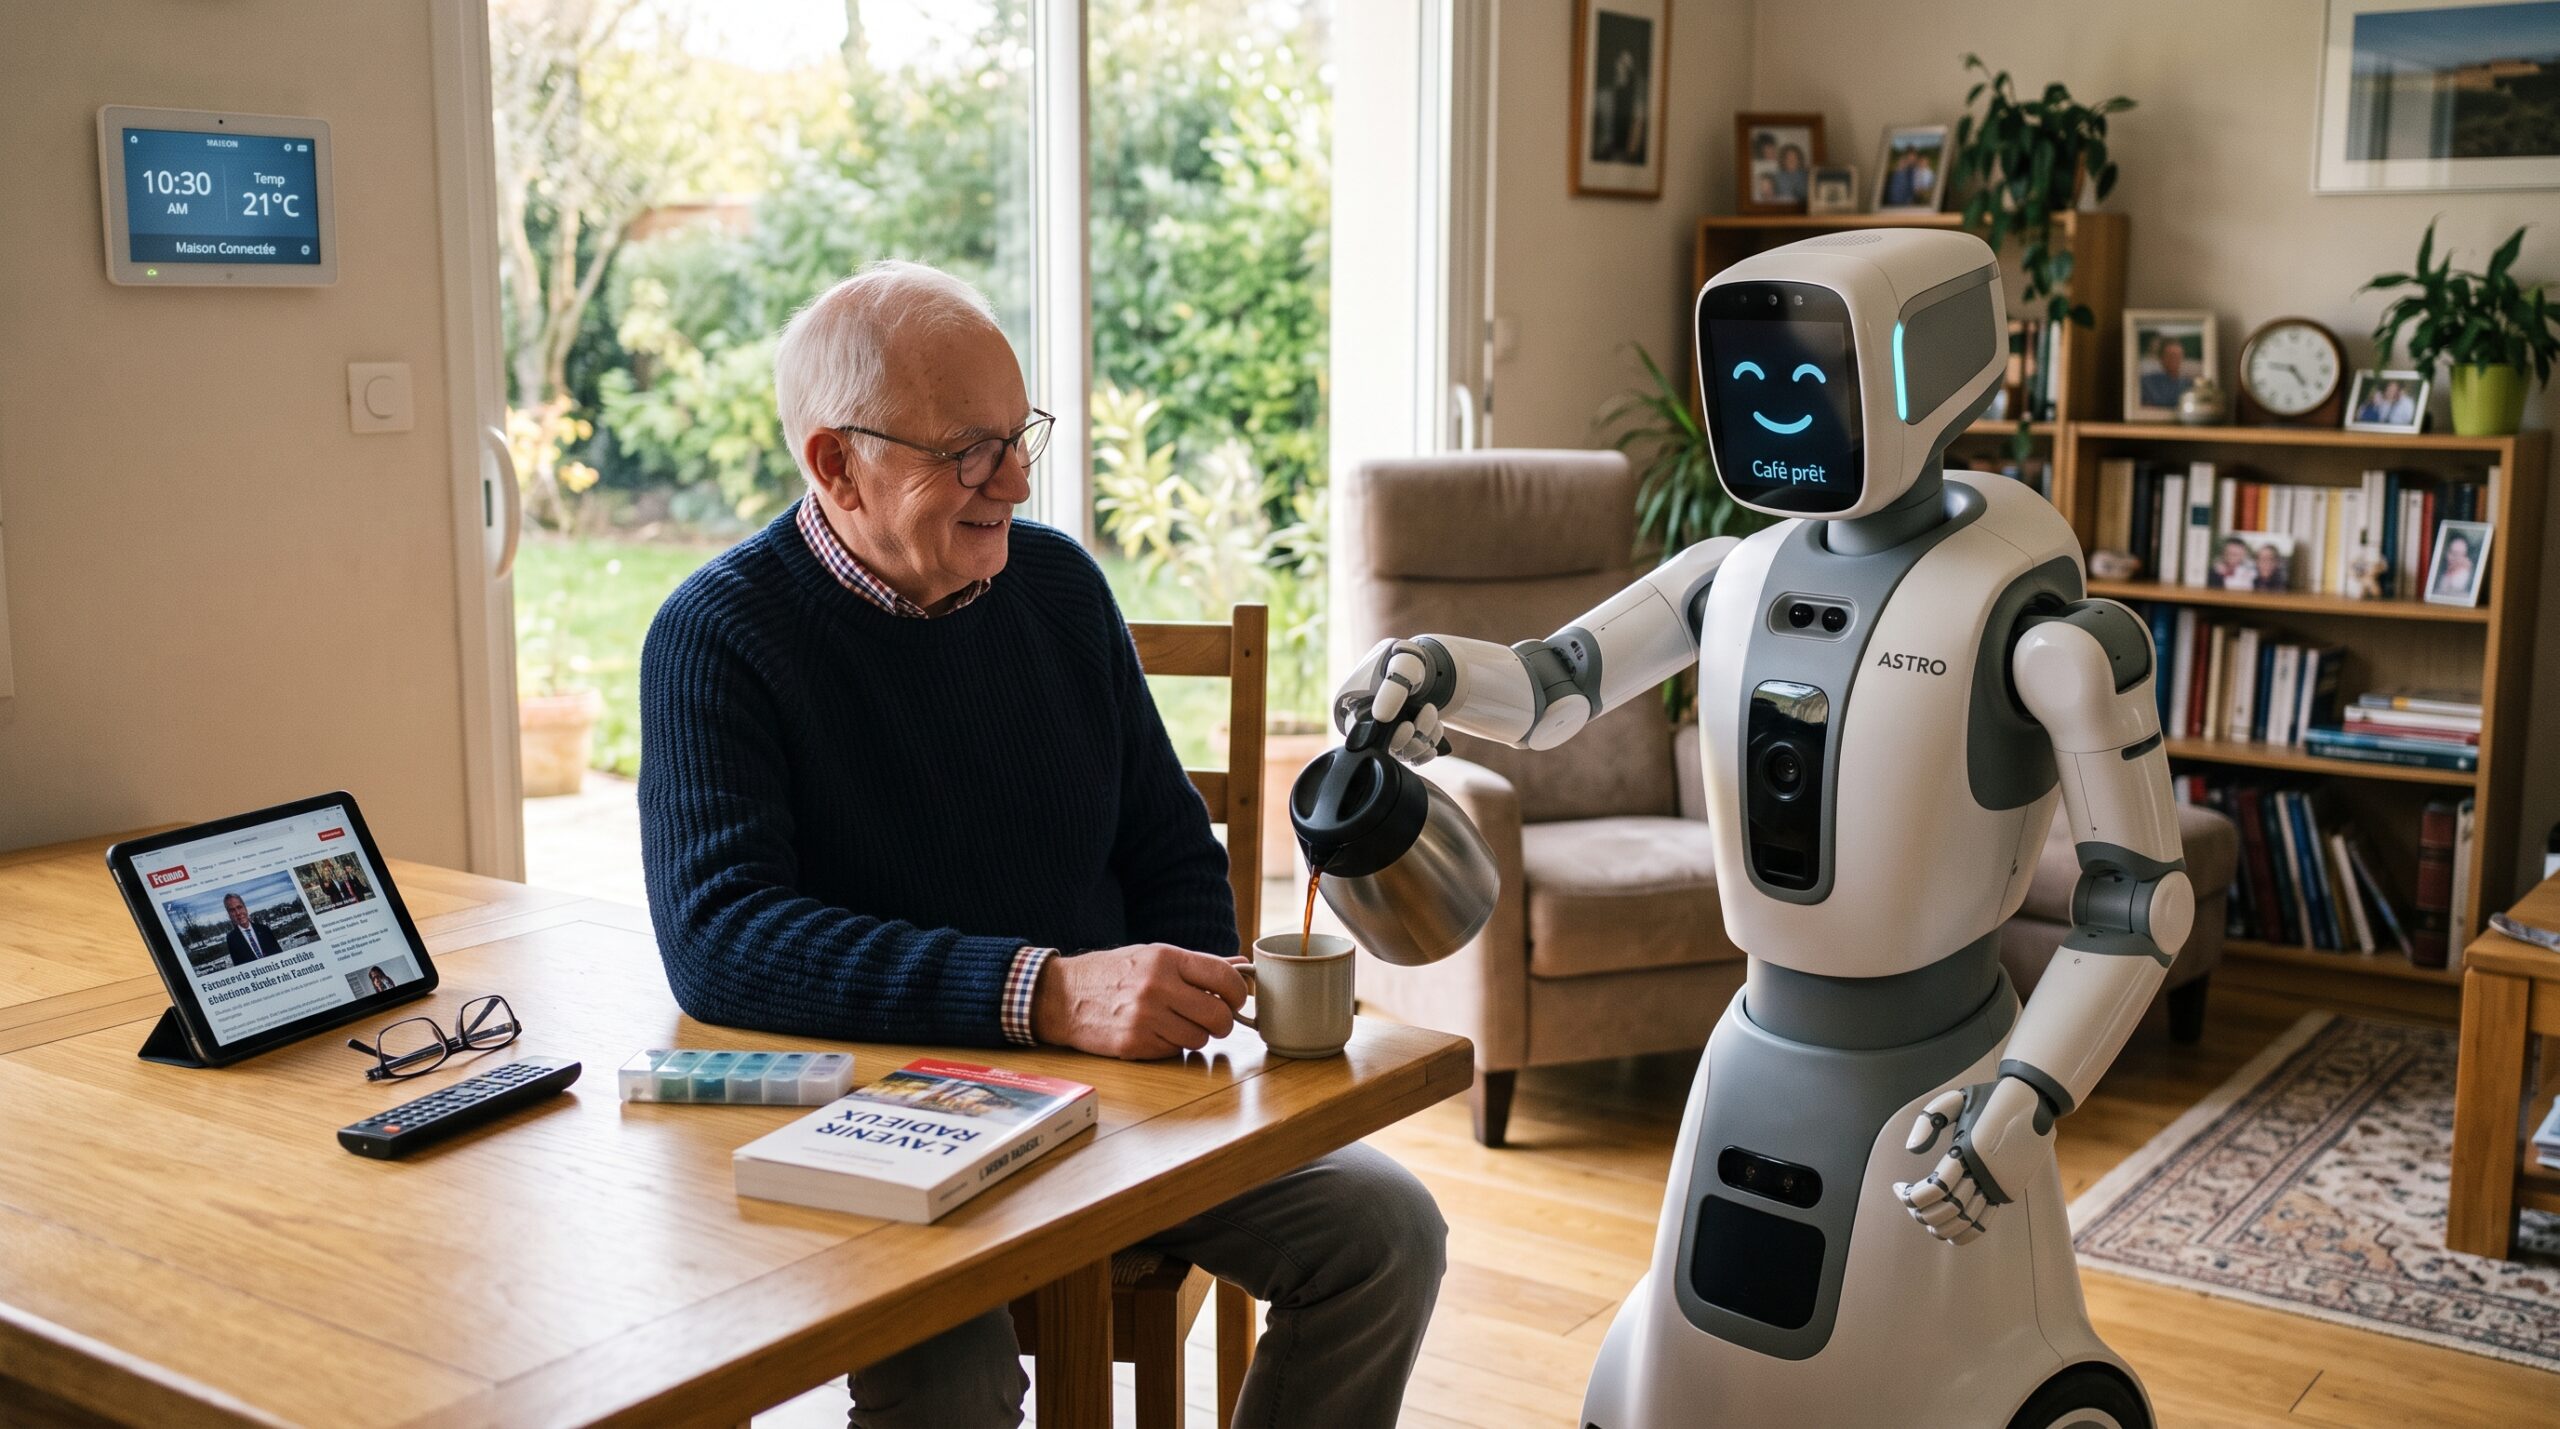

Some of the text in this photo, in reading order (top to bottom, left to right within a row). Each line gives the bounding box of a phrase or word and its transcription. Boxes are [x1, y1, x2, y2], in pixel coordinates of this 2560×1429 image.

[143, 170, 212, 195] 10:30
[253, 172, 286, 188] Temp
[167, 203, 188, 215] AM
[242, 192, 300, 217] 21°C
[176, 242, 277, 255] Maison Connectée
[1752, 460, 1827, 486] Café prêt
[1877, 651, 1947, 677] ASTRO
[834, 1110, 982, 1142] RADIEUX
[815, 1122, 960, 1156] L'AVENIR
